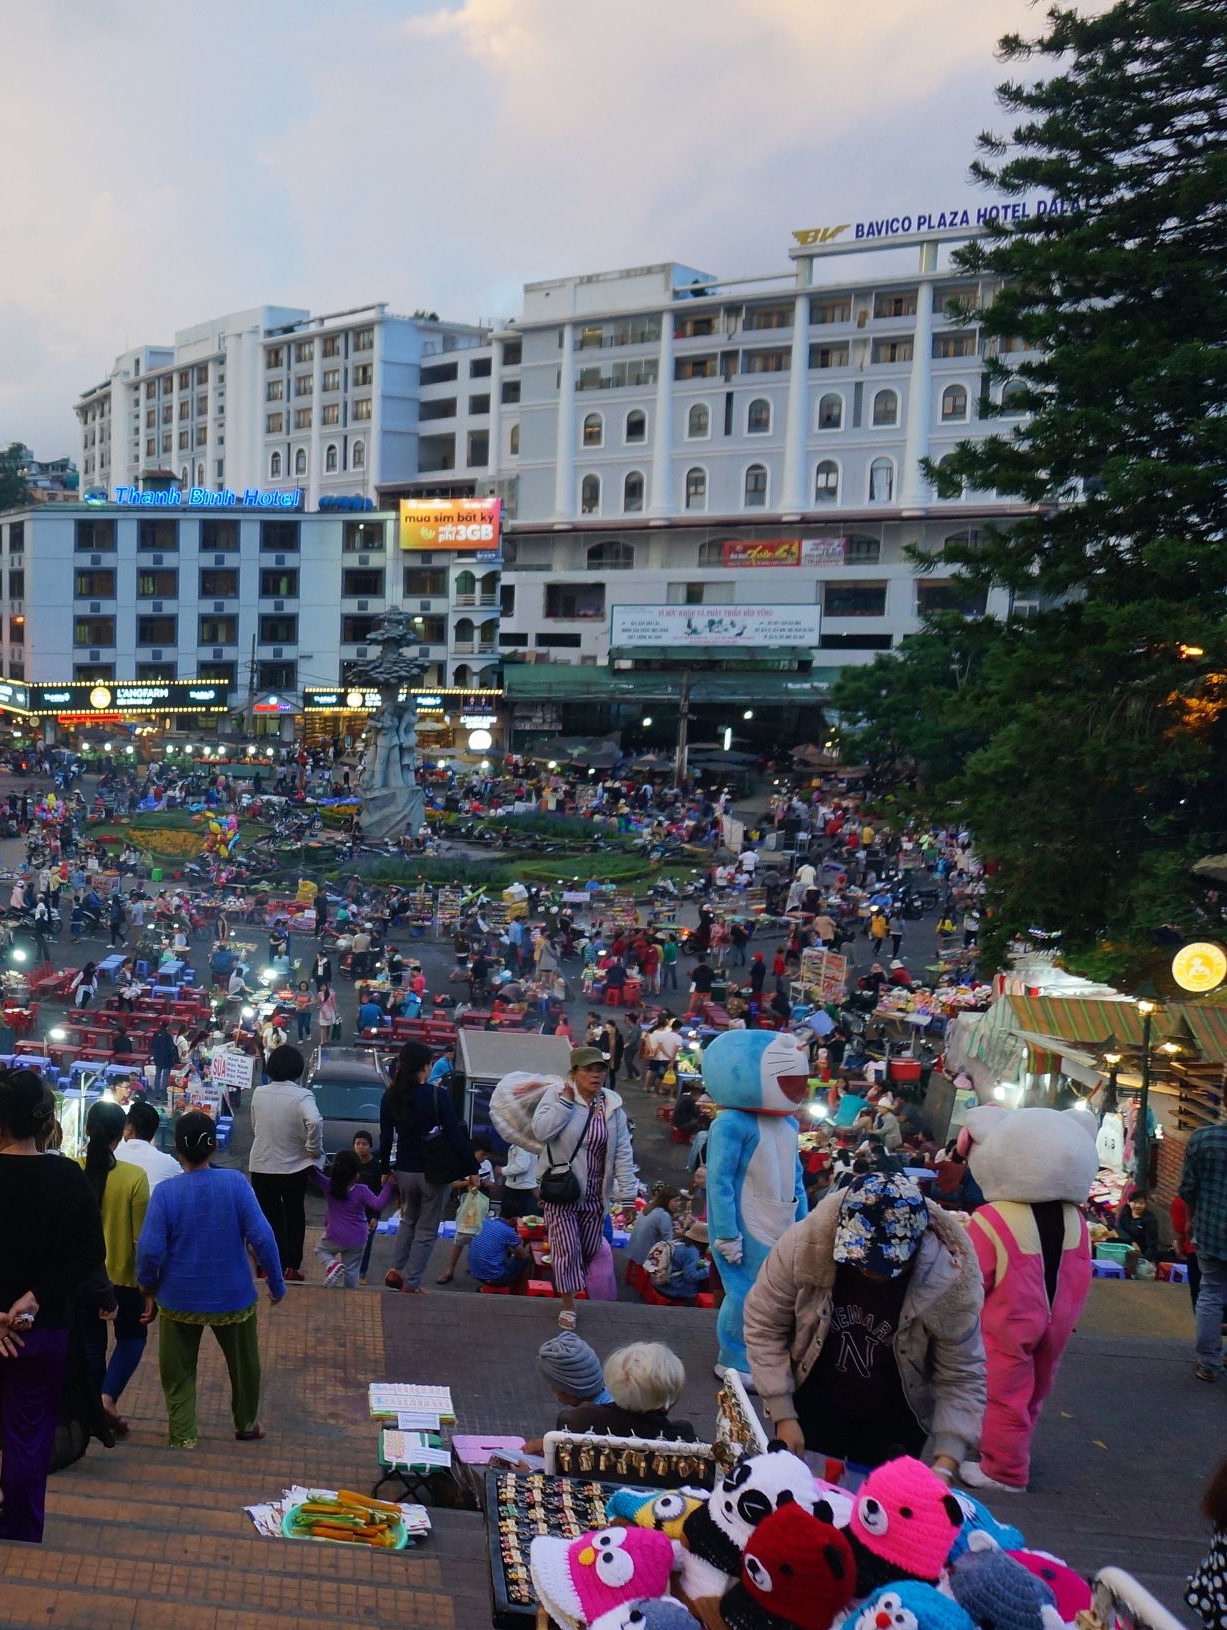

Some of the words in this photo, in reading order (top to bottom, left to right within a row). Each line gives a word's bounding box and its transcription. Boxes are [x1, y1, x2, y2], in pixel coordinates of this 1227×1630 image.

[855, 216, 912, 239] BAVICO
[917, 209, 970, 231] PLAZA
[976, 202, 1030, 224] HOTEL
[114, 485, 182, 505] Thanh
[242, 488, 301, 507] Hotel
[405, 515, 431, 523] mua
[434, 512, 455, 523] sim
[456, 523, 494, 541] 3GB
[835, 1331, 879, 1378] N
